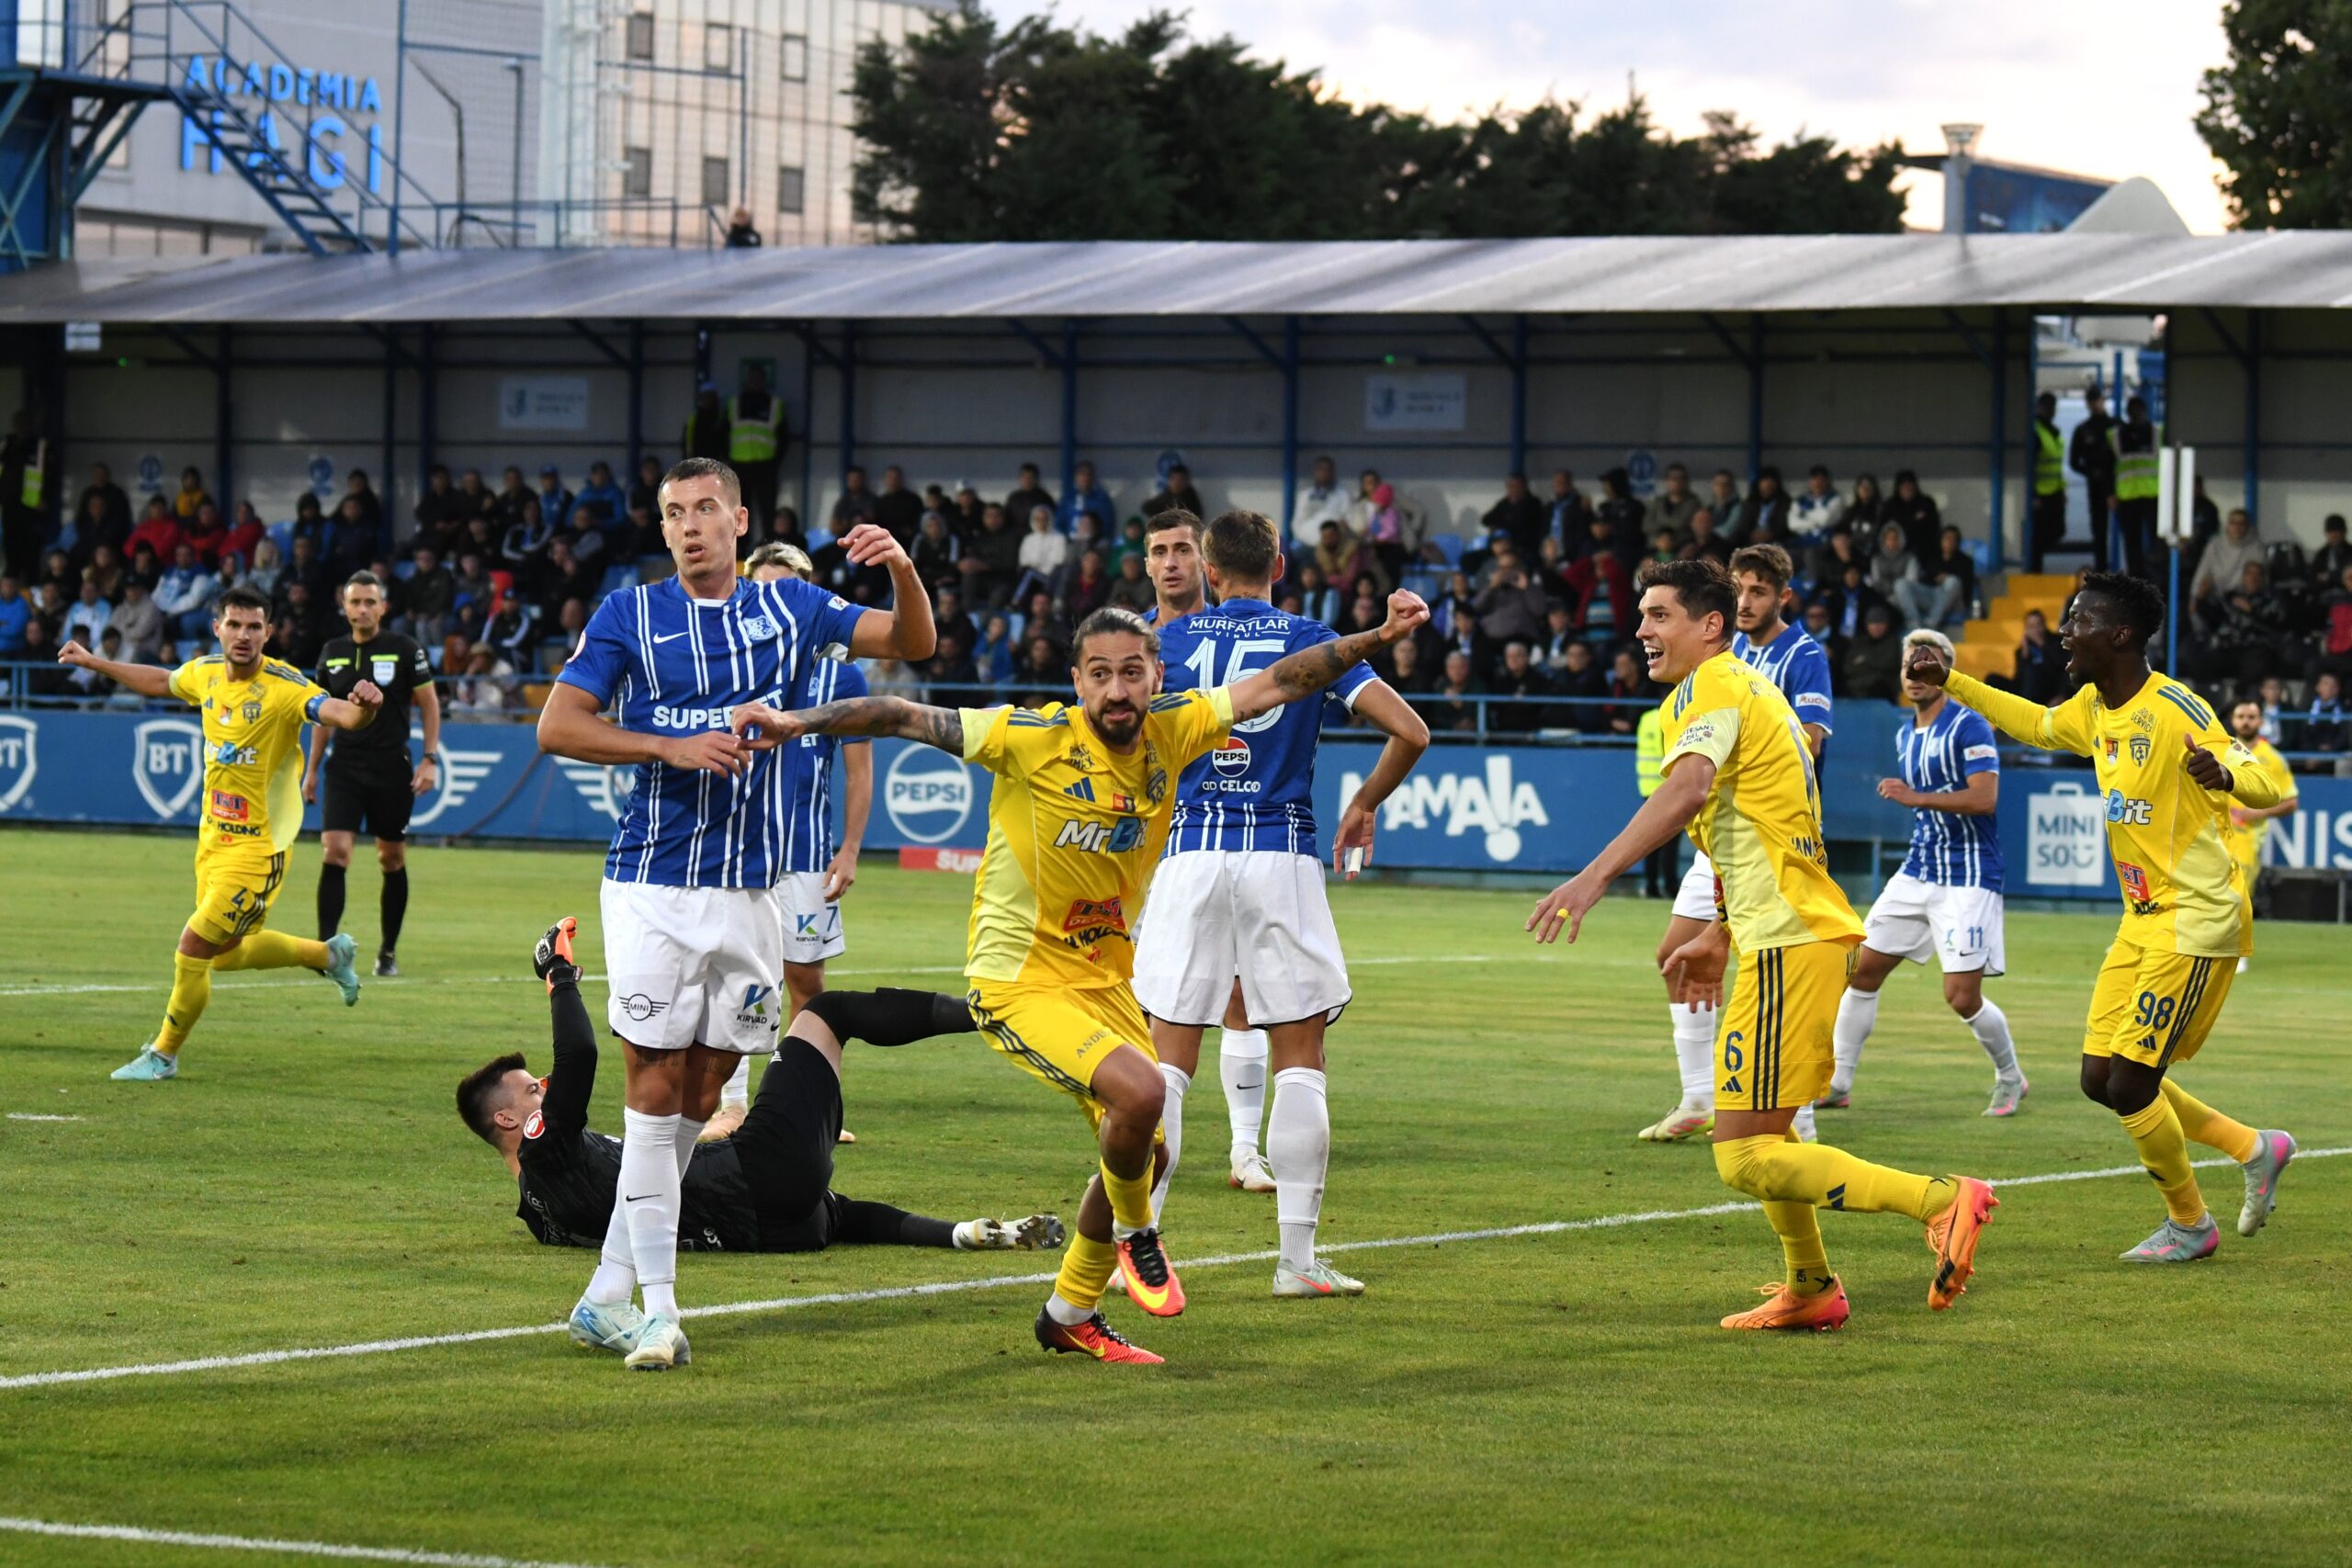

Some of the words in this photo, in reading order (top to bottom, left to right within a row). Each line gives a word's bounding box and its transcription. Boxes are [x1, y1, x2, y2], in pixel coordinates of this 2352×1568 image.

[187, 53, 382, 113] ACADEMIA
[182, 109, 382, 195] HAGI
[1188, 617, 1290, 633] MURFATLAR
[1216, 630, 1261, 638] VINUL
[1184, 637, 1286, 733] 15
[652, 689, 783, 729] SUPET
[0, 739, 23, 769] T
[149, 743, 188, 774] BT
[1214, 751, 1250, 761] PEPSI
[892, 782, 965, 803] PEPSI
[2101, 788, 2153, 825] Bit
[2037, 815, 2097, 837] MINI
[232, 886, 248, 909] 4
[825, 905, 839, 932] 7
[1967, 926, 1984, 949] 11
[629, 1002, 650, 1012] MINI
[736, 1013, 769, 1024] KIRVAD
[2134, 990, 2176, 1031] 98
[1724, 1031, 1744, 1073] 6
